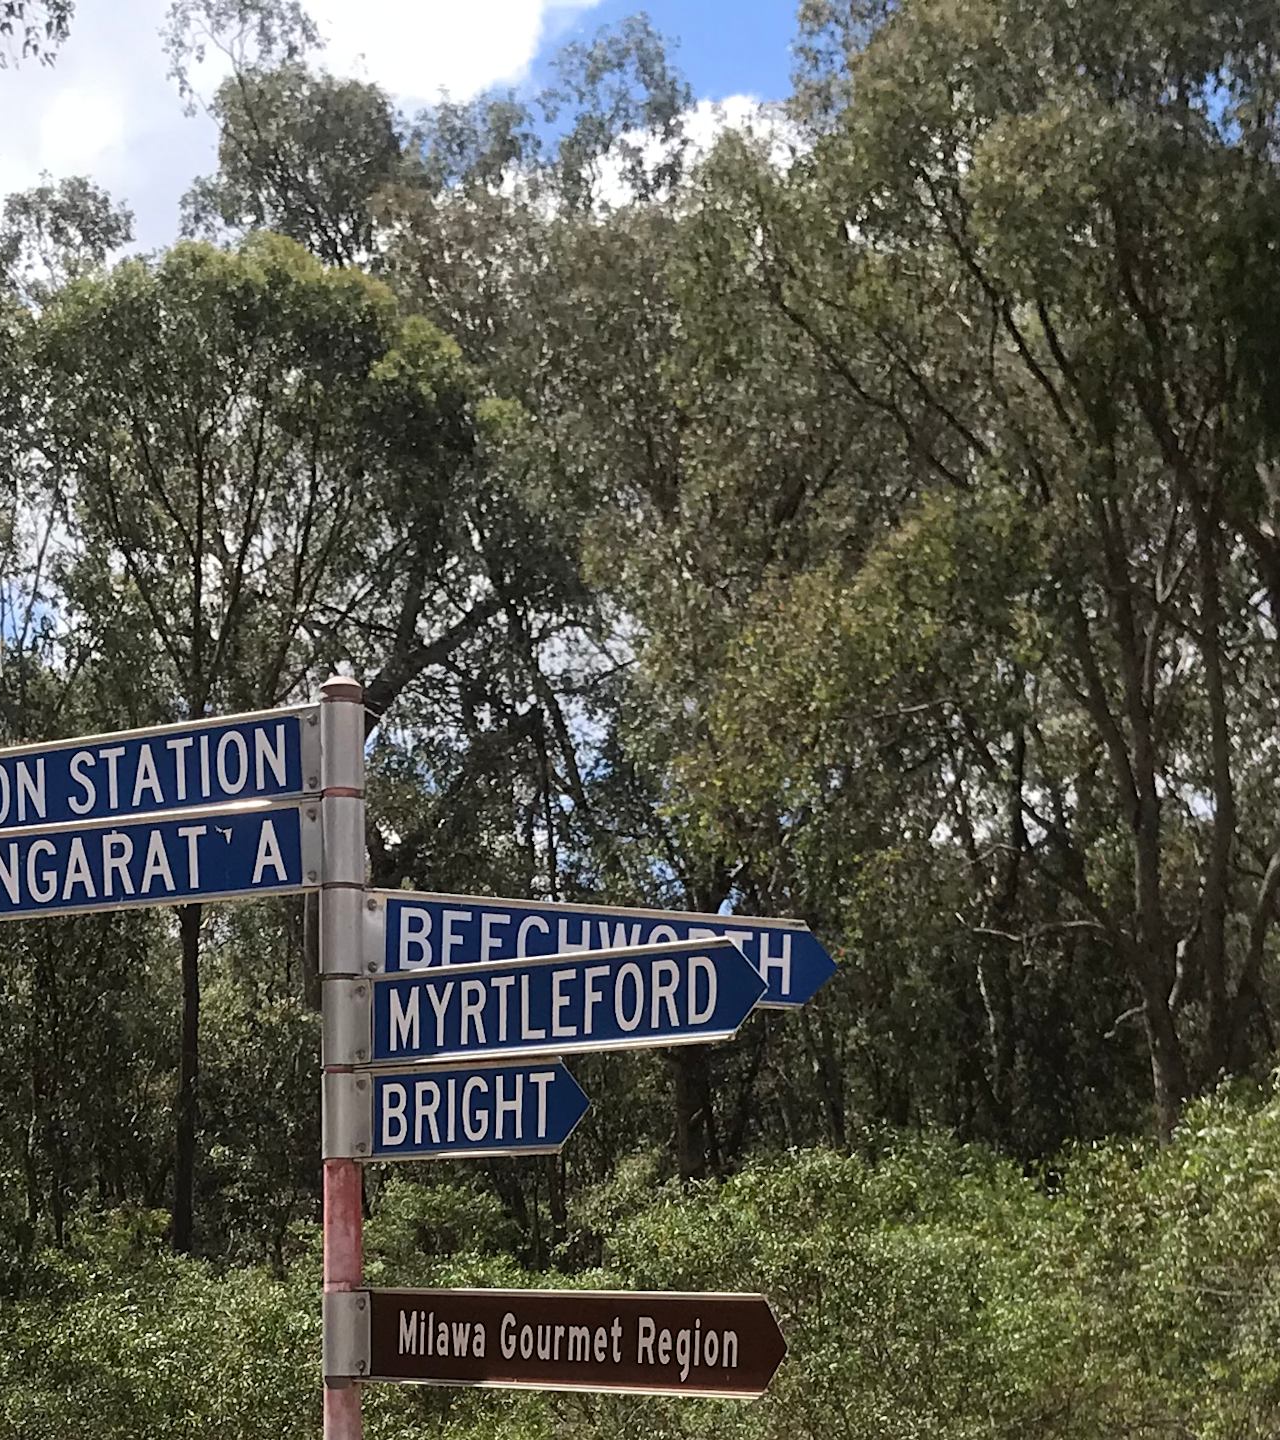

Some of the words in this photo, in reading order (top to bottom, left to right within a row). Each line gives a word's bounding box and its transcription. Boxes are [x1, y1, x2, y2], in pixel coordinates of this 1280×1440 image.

[66, 723, 288, 816] STATION
[399, 906, 793, 996] BEECHH
[388, 956, 718, 1052] MYRTLEFORD
[381, 1071, 557, 1147] BRIGHT
[398, 1309, 487, 1359] Milawa
[499, 1311, 623, 1363] Gourmet
[636, 1316, 740, 1383] Region
